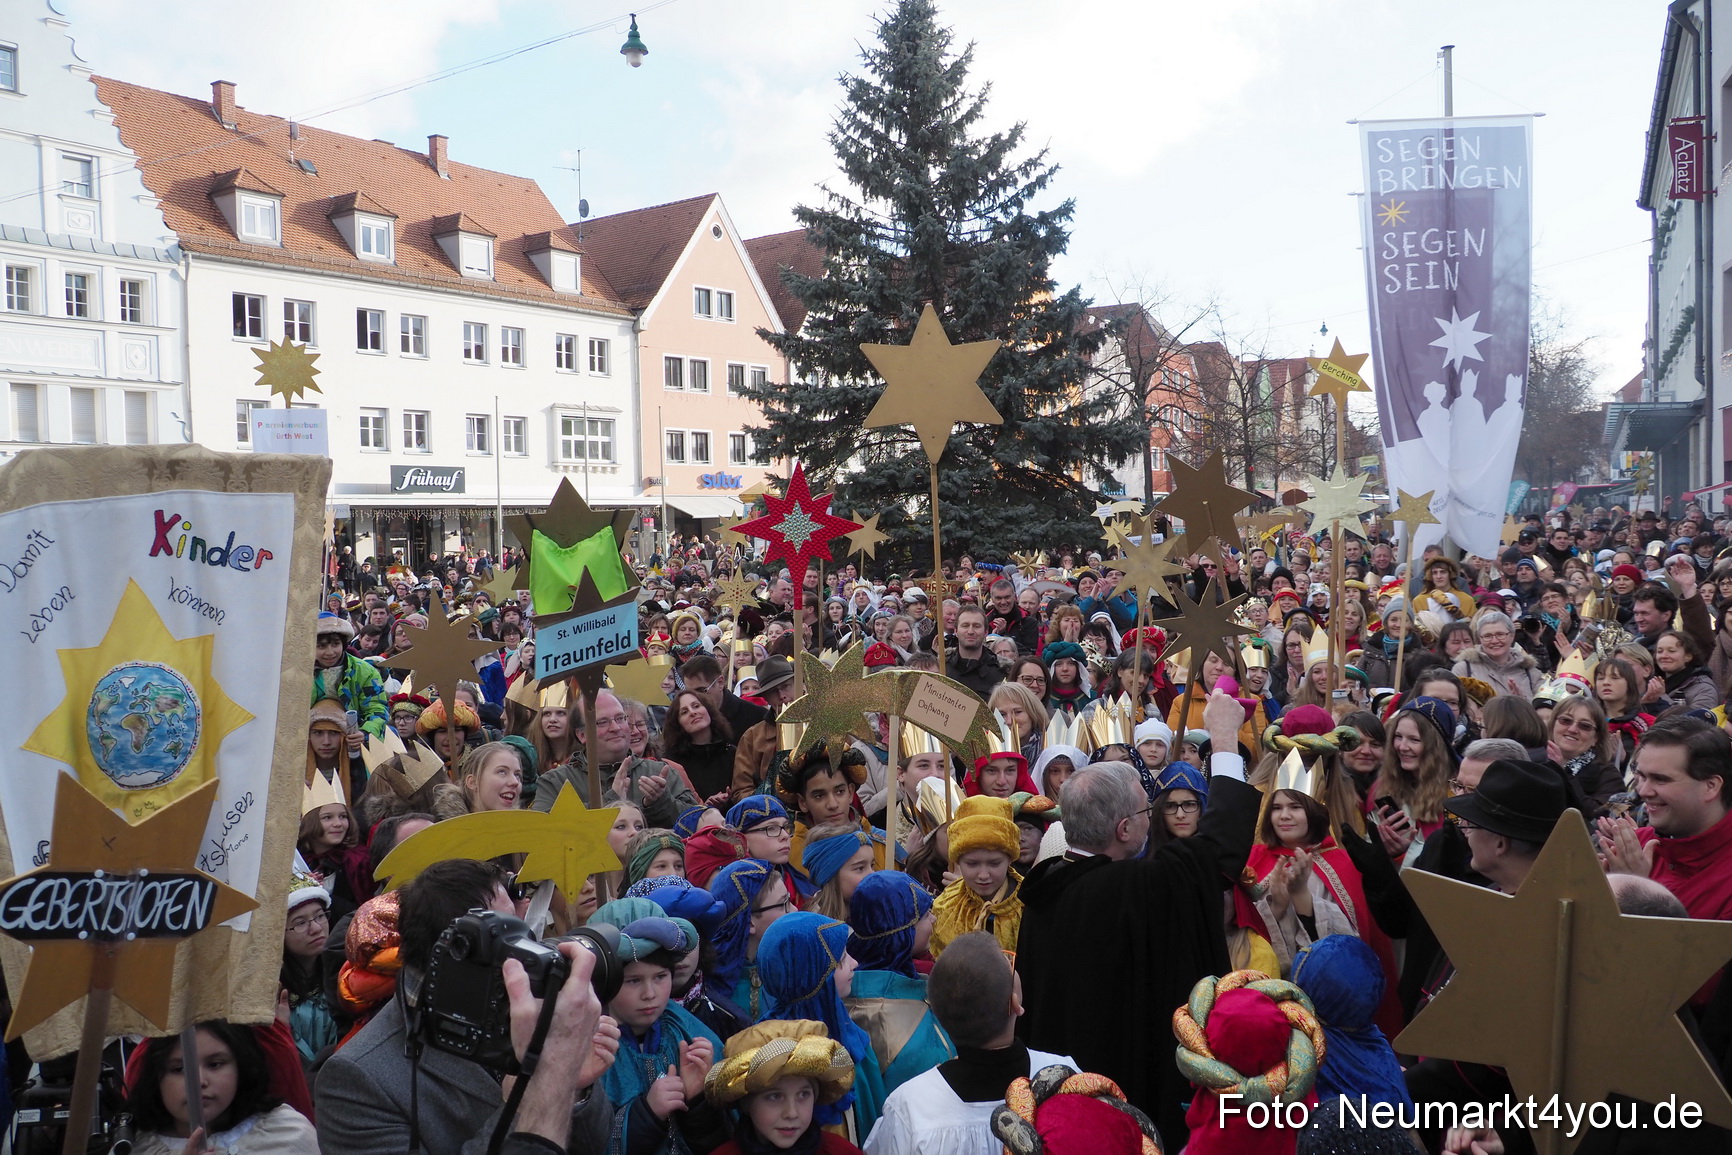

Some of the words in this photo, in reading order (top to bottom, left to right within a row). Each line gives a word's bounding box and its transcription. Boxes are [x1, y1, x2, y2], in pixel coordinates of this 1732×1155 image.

[1376, 135, 1481, 163] SEGEN
[1675, 136, 1696, 194] Achatz
[1377, 163, 1522, 196] BRINGEN
[1382, 227, 1486, 260] SEGEN
[1383, 259, 1460, 294] SEIN
[1321, 361, 1358, 387] Berching
[395, 467, 464, 492] frühauf
[0, 529, 55, 593] Damit
[149, 509, 273, 572] Kinder
[168, 576, 226, 626] können
[919, 582, 958, 595] CHRSTO
[557, 630, 570, 640] St.
[572, 614, 616, 635] Willibald
[541, 629, 631, 673] Traunfeld
[917, 699, 950, 727] Daßwang
[923, 681, 967, 712] Ministranten
[0, 877, 213, 934] GEBERTSHOFEN
